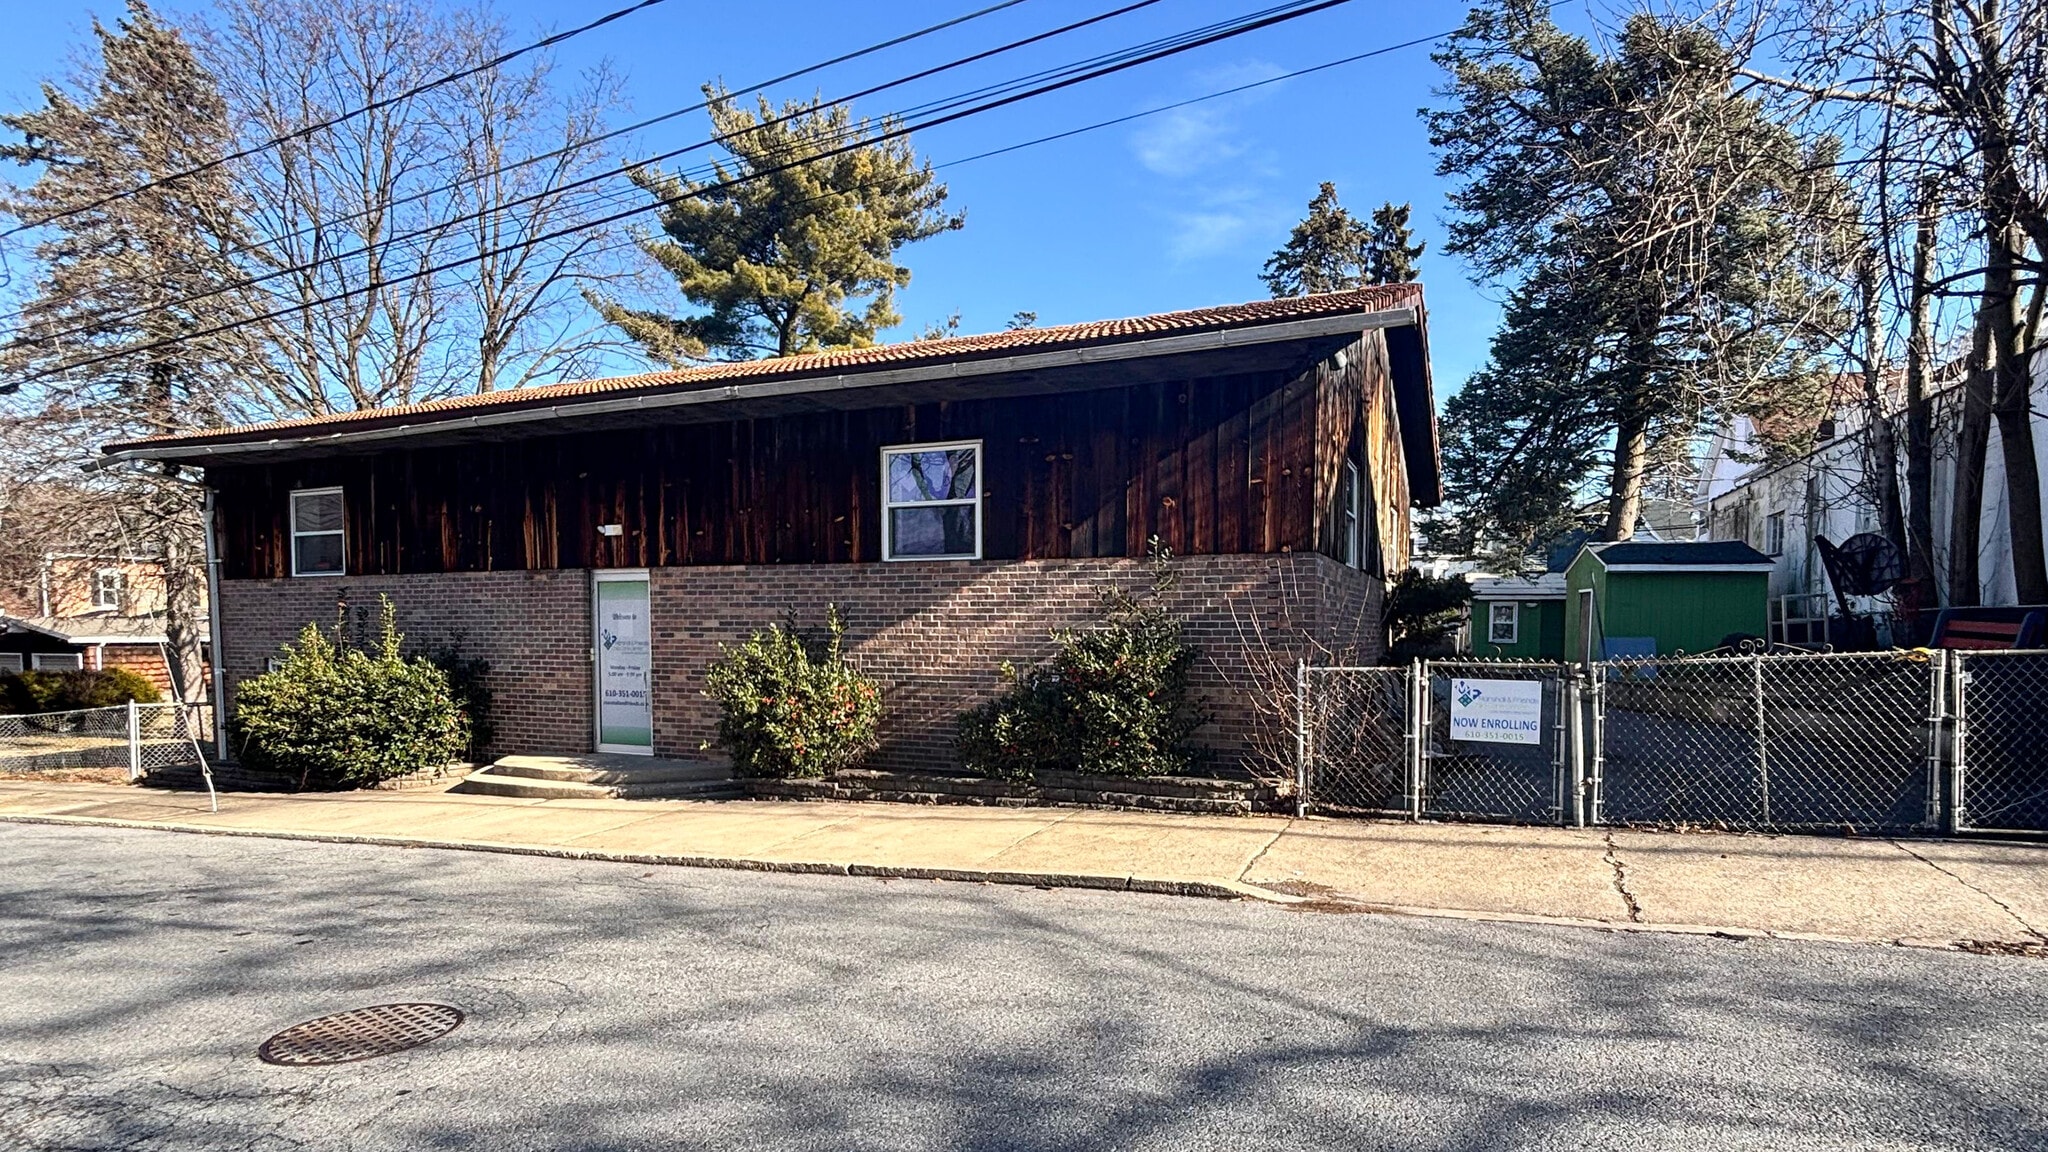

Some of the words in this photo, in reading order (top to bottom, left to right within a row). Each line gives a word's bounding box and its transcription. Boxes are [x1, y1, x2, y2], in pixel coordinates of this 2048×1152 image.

[1453, 717, 1479, 728] NOW
[1481, 718, 1538, 731] ENROLLING
[1465, 731, 1524, 741] 610-351-0015
